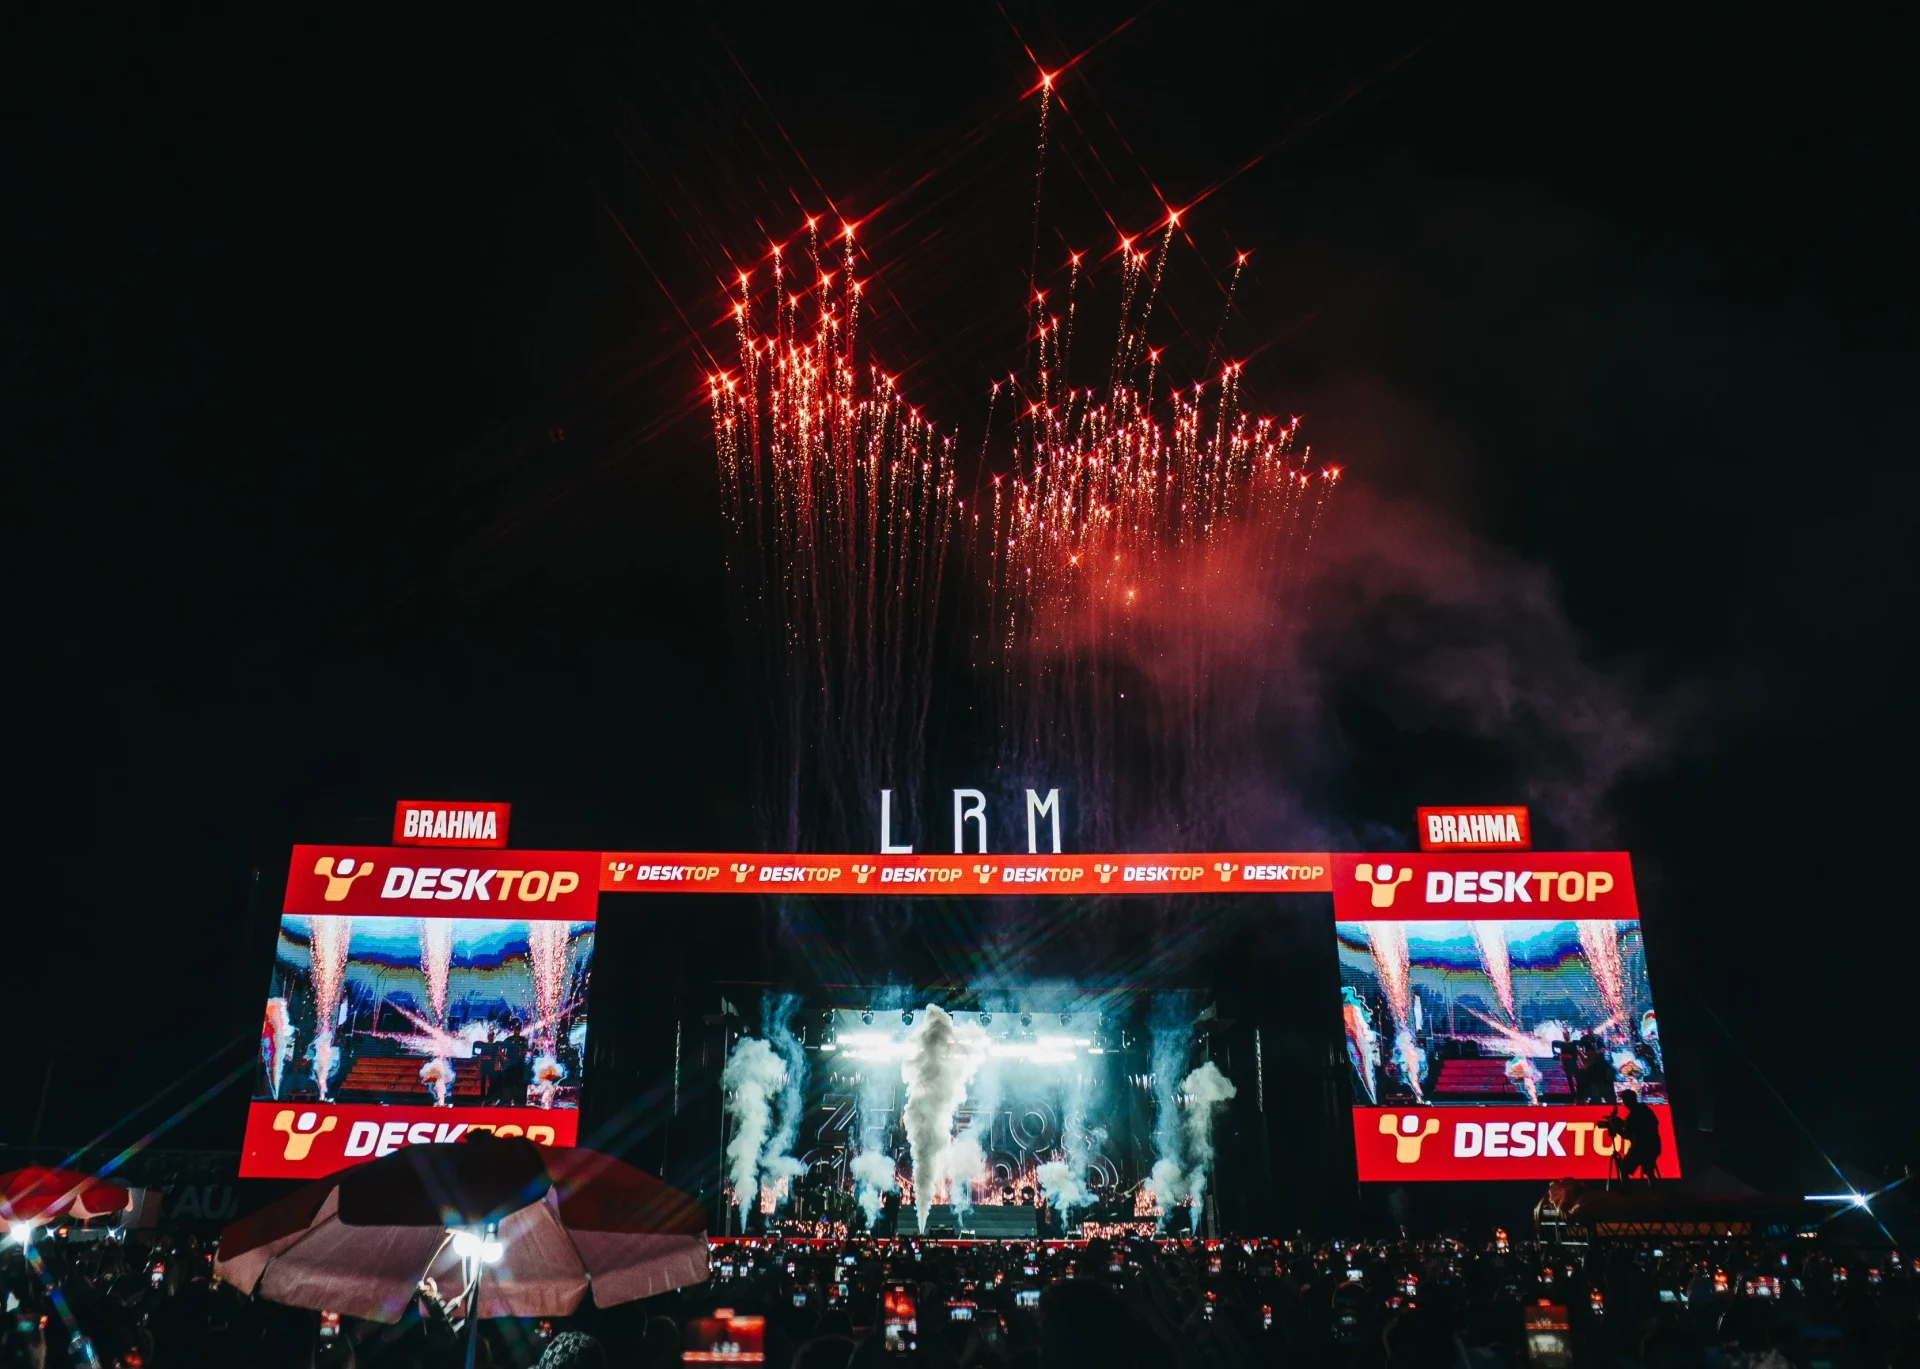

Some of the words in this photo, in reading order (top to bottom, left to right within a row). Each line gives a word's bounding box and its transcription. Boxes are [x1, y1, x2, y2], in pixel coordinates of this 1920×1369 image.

[403, 809, 497, 840] BRAHMA
[1427, 814, 1521, 844] BRAHMA
[380, 866, 580, 903] DESKTOP
[636, 865, 720, 881] DESKTOP
[758, 866, 842, 882] DESKTOP
[880, 867, 964, 883] DESKTOP
[1002, 867, 1084, 883] DESKTOP
[1123, 866, 1205, 882] DESKTOP
[1243, 865, 1325, 881] DESKTOP
[1425, 871, 1615, 903] DESKTOP
[343, 1120, 556, 1158] DESKP
[1453, 1121, 1632, 1158] DESKTO
